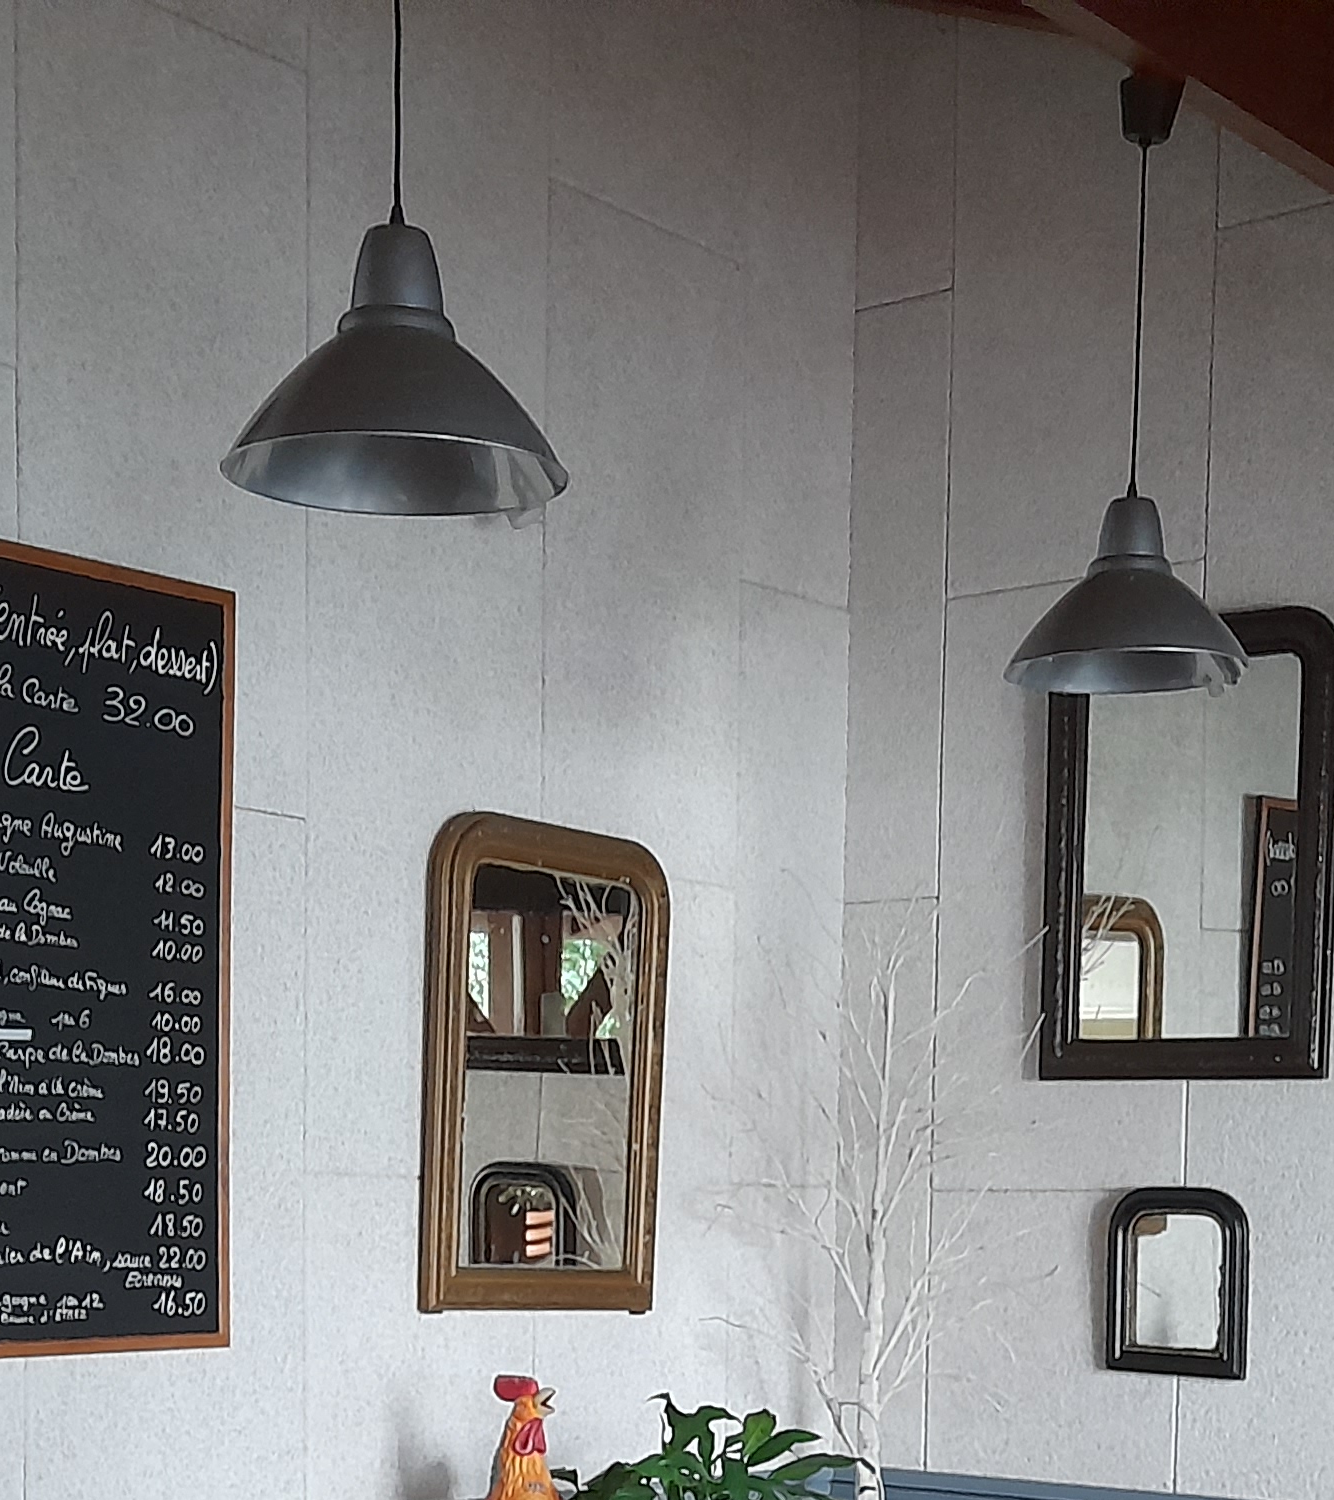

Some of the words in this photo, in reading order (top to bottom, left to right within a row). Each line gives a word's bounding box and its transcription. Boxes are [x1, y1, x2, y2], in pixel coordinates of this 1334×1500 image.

[78, 611, 138, 673] plat,
[138, 627, 221, 695] dessert)
[102, 686, 194, 737] 32.00
[3, 726, 89, 792] Carte
[40, 812, 123, 856] Augustine
[150, 833, 204, 863] 13.00
[155, 873, 205, 898] 12.00
[0, 898, 17, 913] au
[23, 888, 72, 926] Cognac
[152, 910, 204, 936] 11.50
[14, 922, 27, 942] la
[151, 939, 204, 963] 10.00
[68, 972, 84, 991] de
[148, 982, 202, 1006] 16.00
[78, 1009, 91, 1029] 6
[151, 1011, 202, 1034] 10.00
[48, 1043, 70, 1062] de
[72, 1039, 89, 1063] la
[146, 1036, 205, 1065] 18.00
[144, 1079, 203, 1104] 19.50
[144, 1107, 199, 1134] 17.50
[42, 1147, 58, 1162] en
[61, 1139, 121, 1164] Dombes
[146, 1141, 207, 1168] 20.00
[143, 1178, 203, 1205] 18.50
[149, 1212, 204, 1238] 18.50
[29, 1242, 53, 1263] de
[112, 1252, 152, 1269] sauce
[158, 1246, 207, 1271] 22.00
[82, 1293, 104, 1309] 12
[152, 1291, 206, 1317] 16.50
